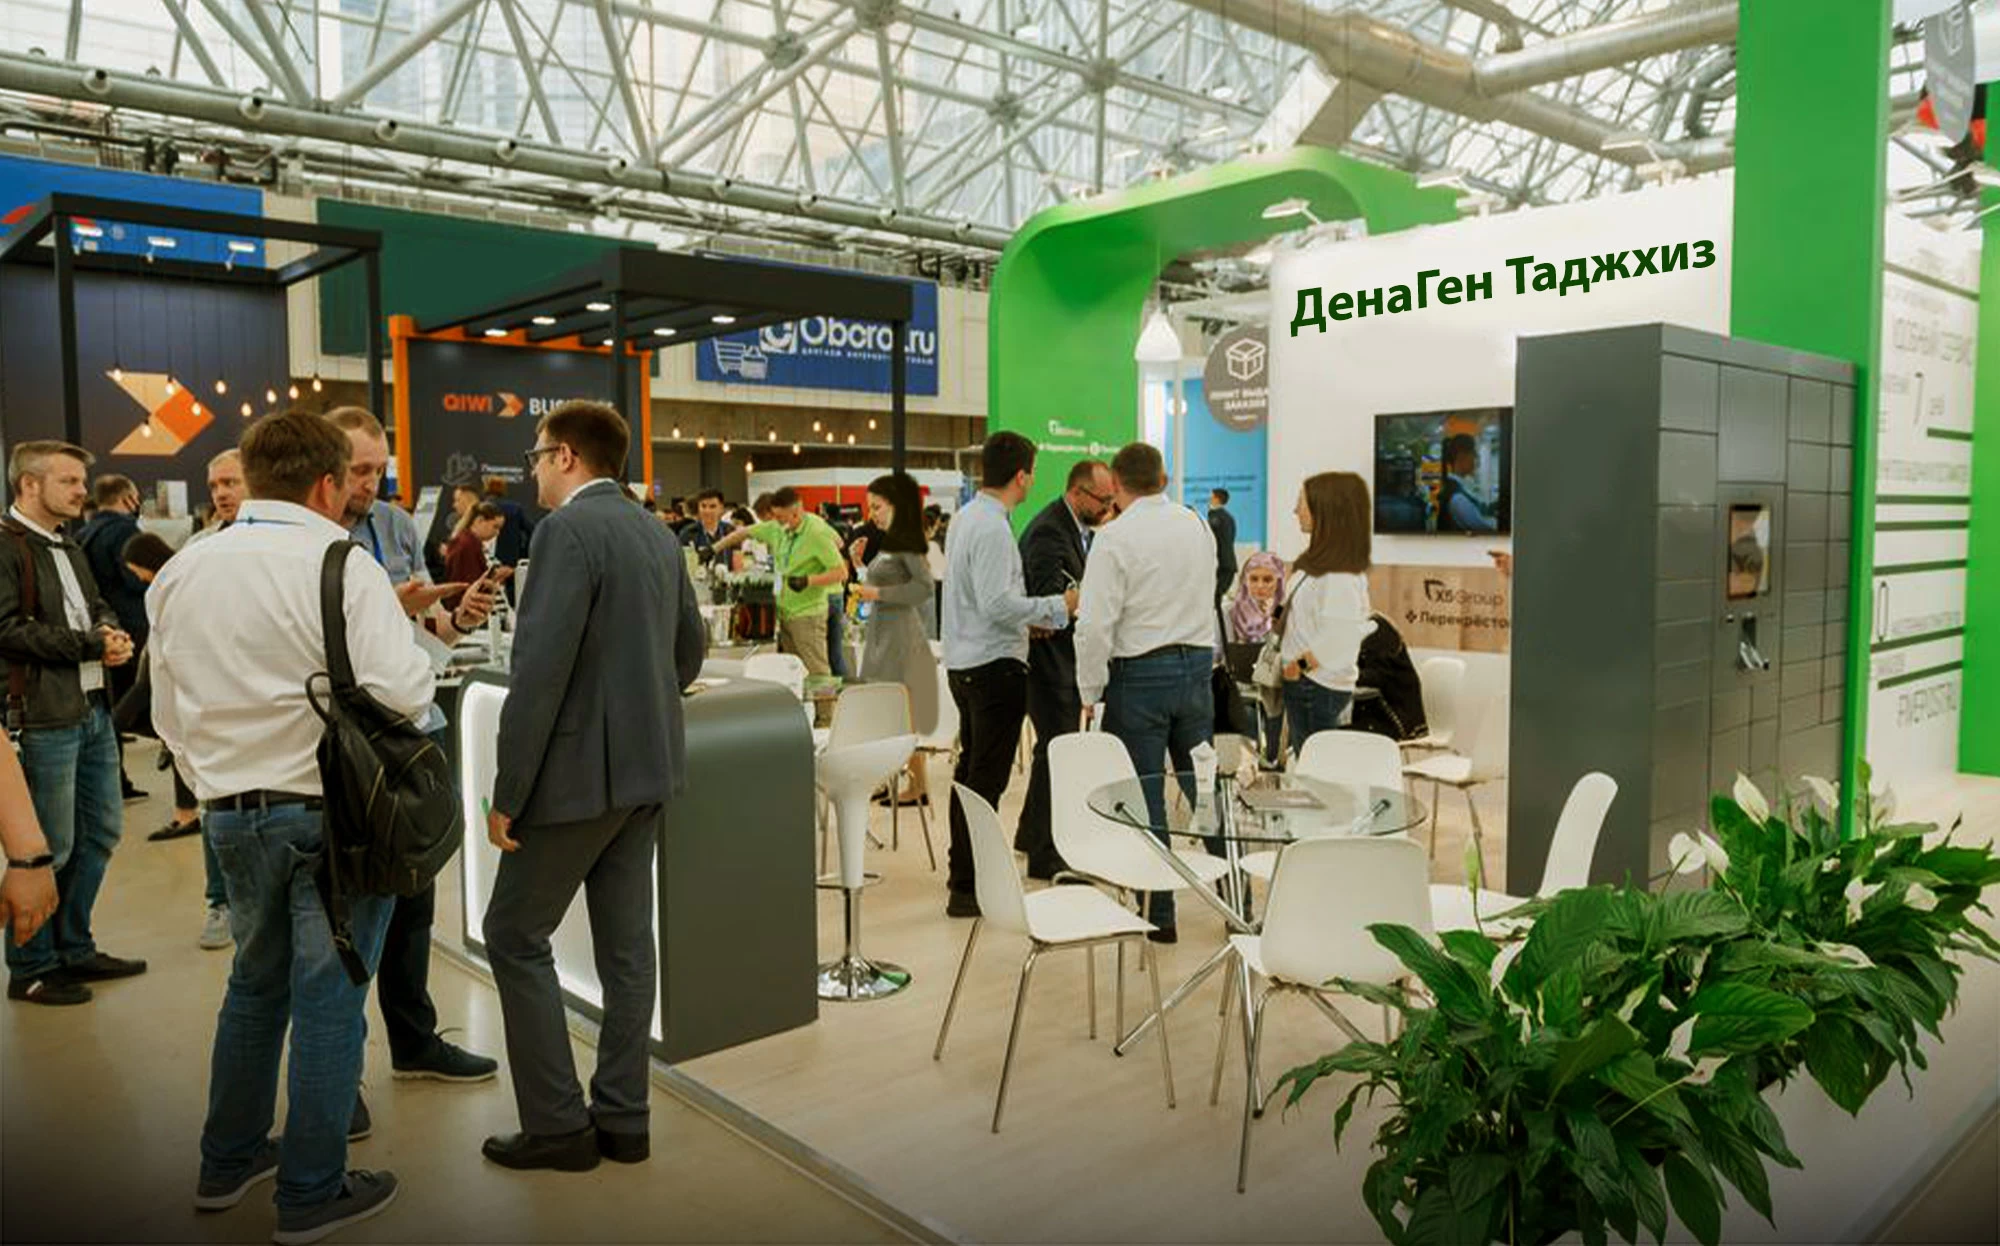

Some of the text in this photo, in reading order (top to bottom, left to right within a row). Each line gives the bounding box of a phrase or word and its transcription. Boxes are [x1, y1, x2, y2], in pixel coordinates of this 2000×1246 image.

[1291, 240, 1715, 337] ДенаГен Таджхиз
[1420, 609, 1509, 629] Перекрёсто
